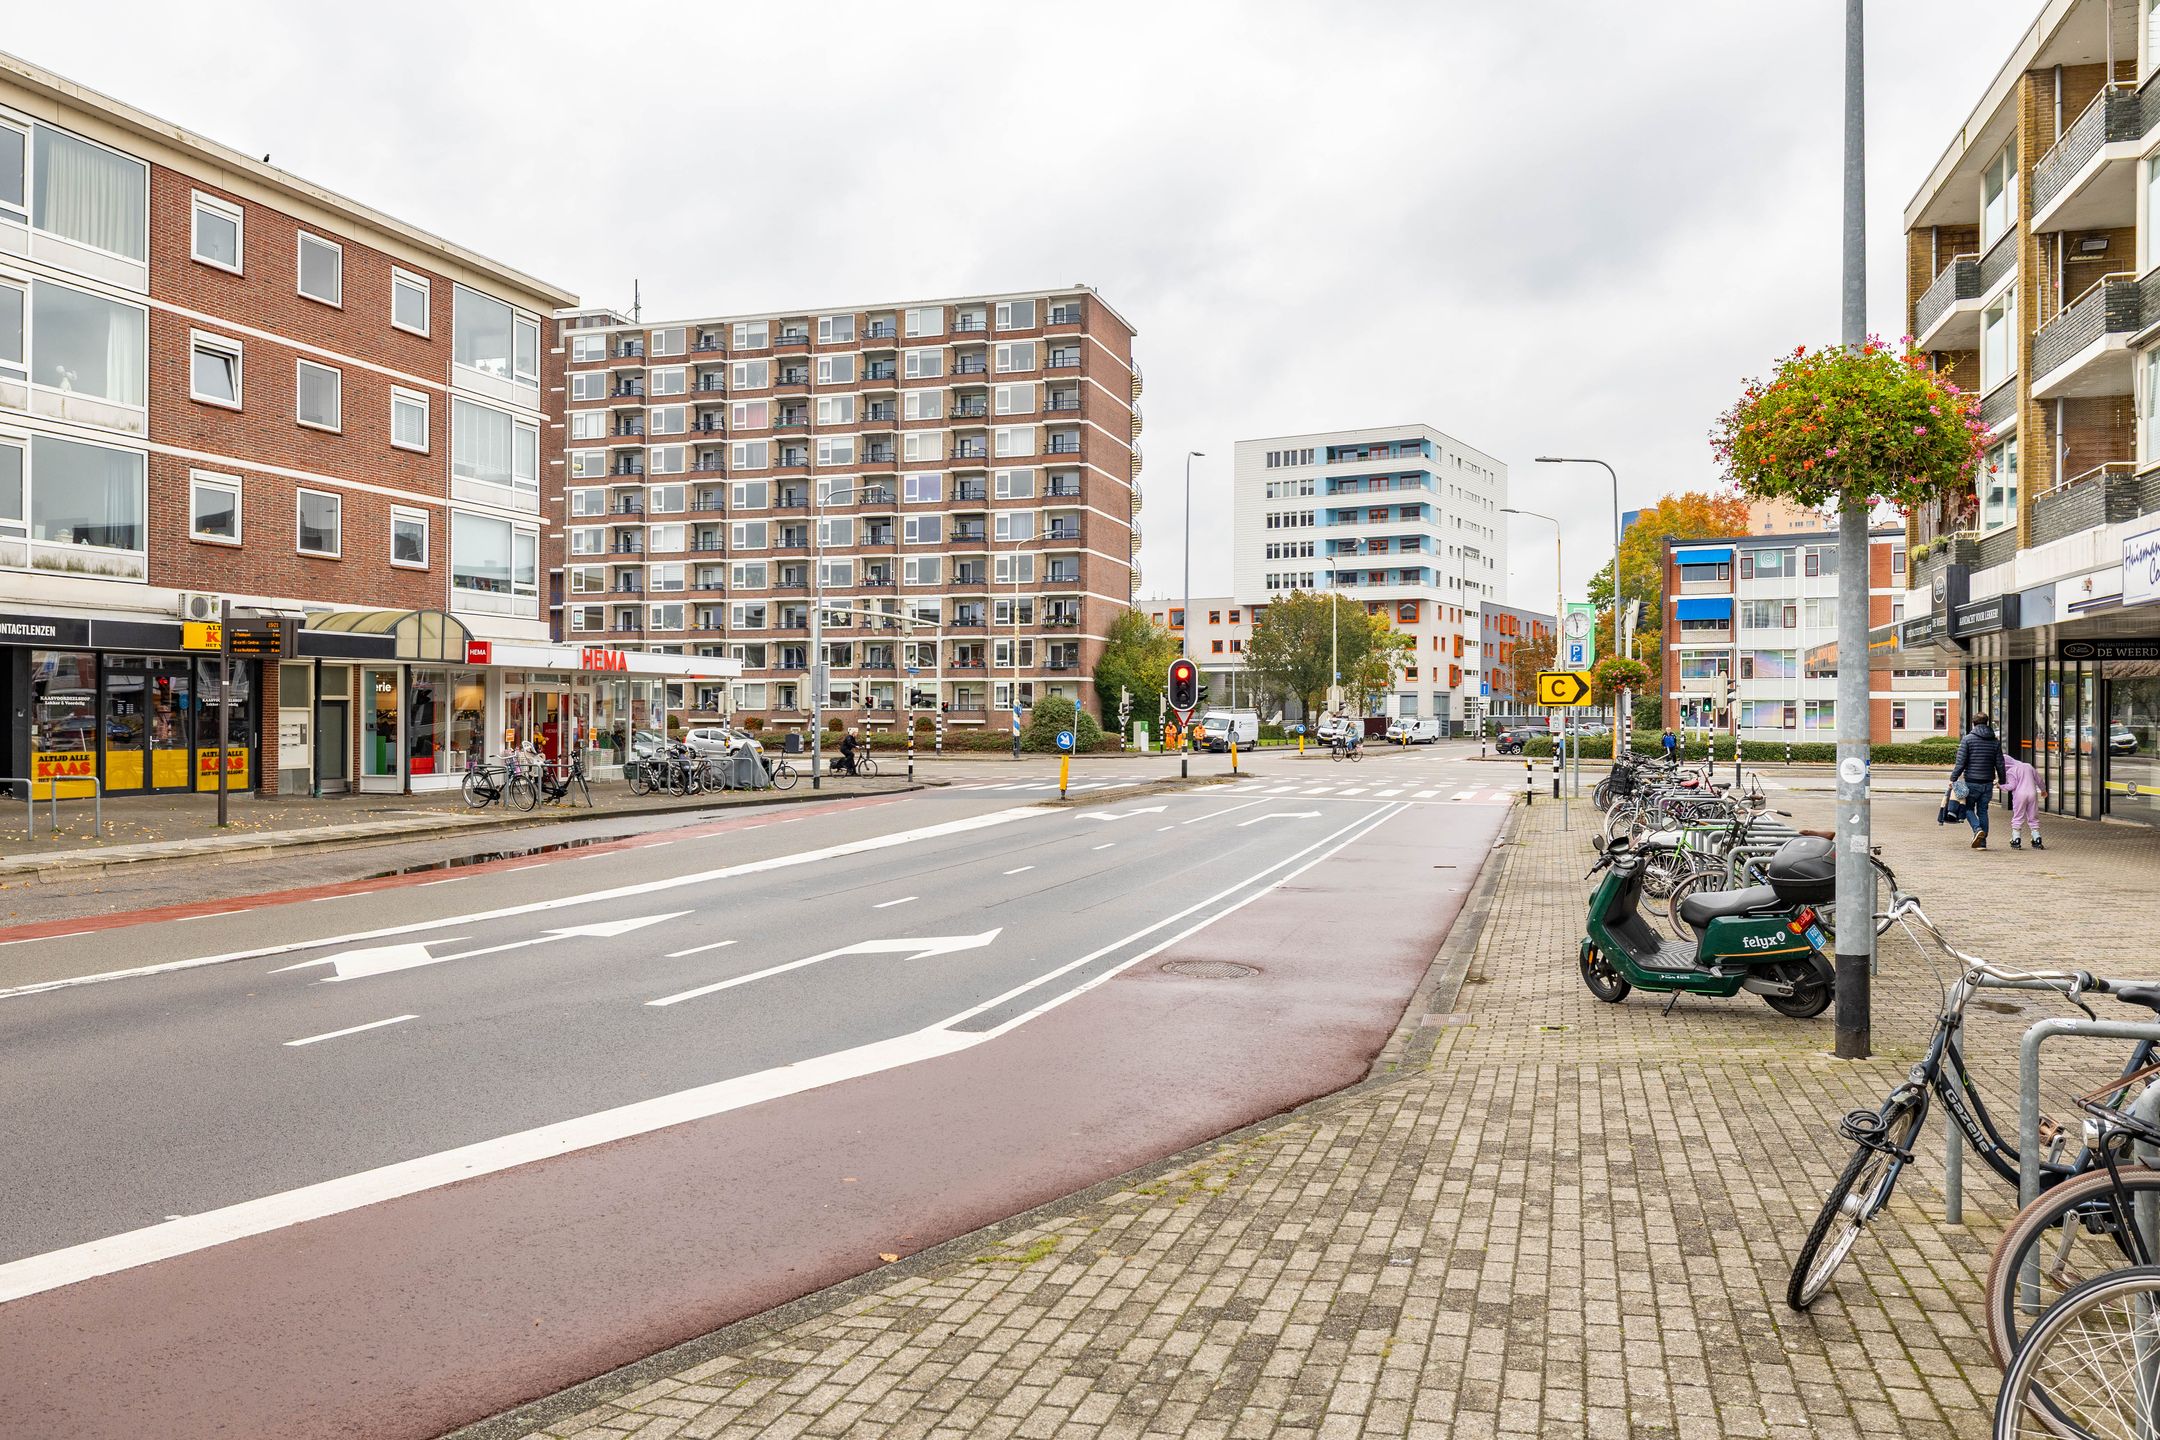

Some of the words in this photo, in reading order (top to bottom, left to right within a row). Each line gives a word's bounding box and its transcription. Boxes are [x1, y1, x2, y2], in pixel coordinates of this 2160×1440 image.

[0, 623, 56, 636] NTACTLENZEN
[2097, 648, 2112, 657] DE
[2116, 647, 2158, 656] WEERD
[582, 649, 628, 672] HEMA
[1551, 679, 1566, 697] C
[38, 762, 91, 777] KAAS
[1742, 935, 1778, 949] felyx
[1945, 1088, 1990, 1153] Gazelle
